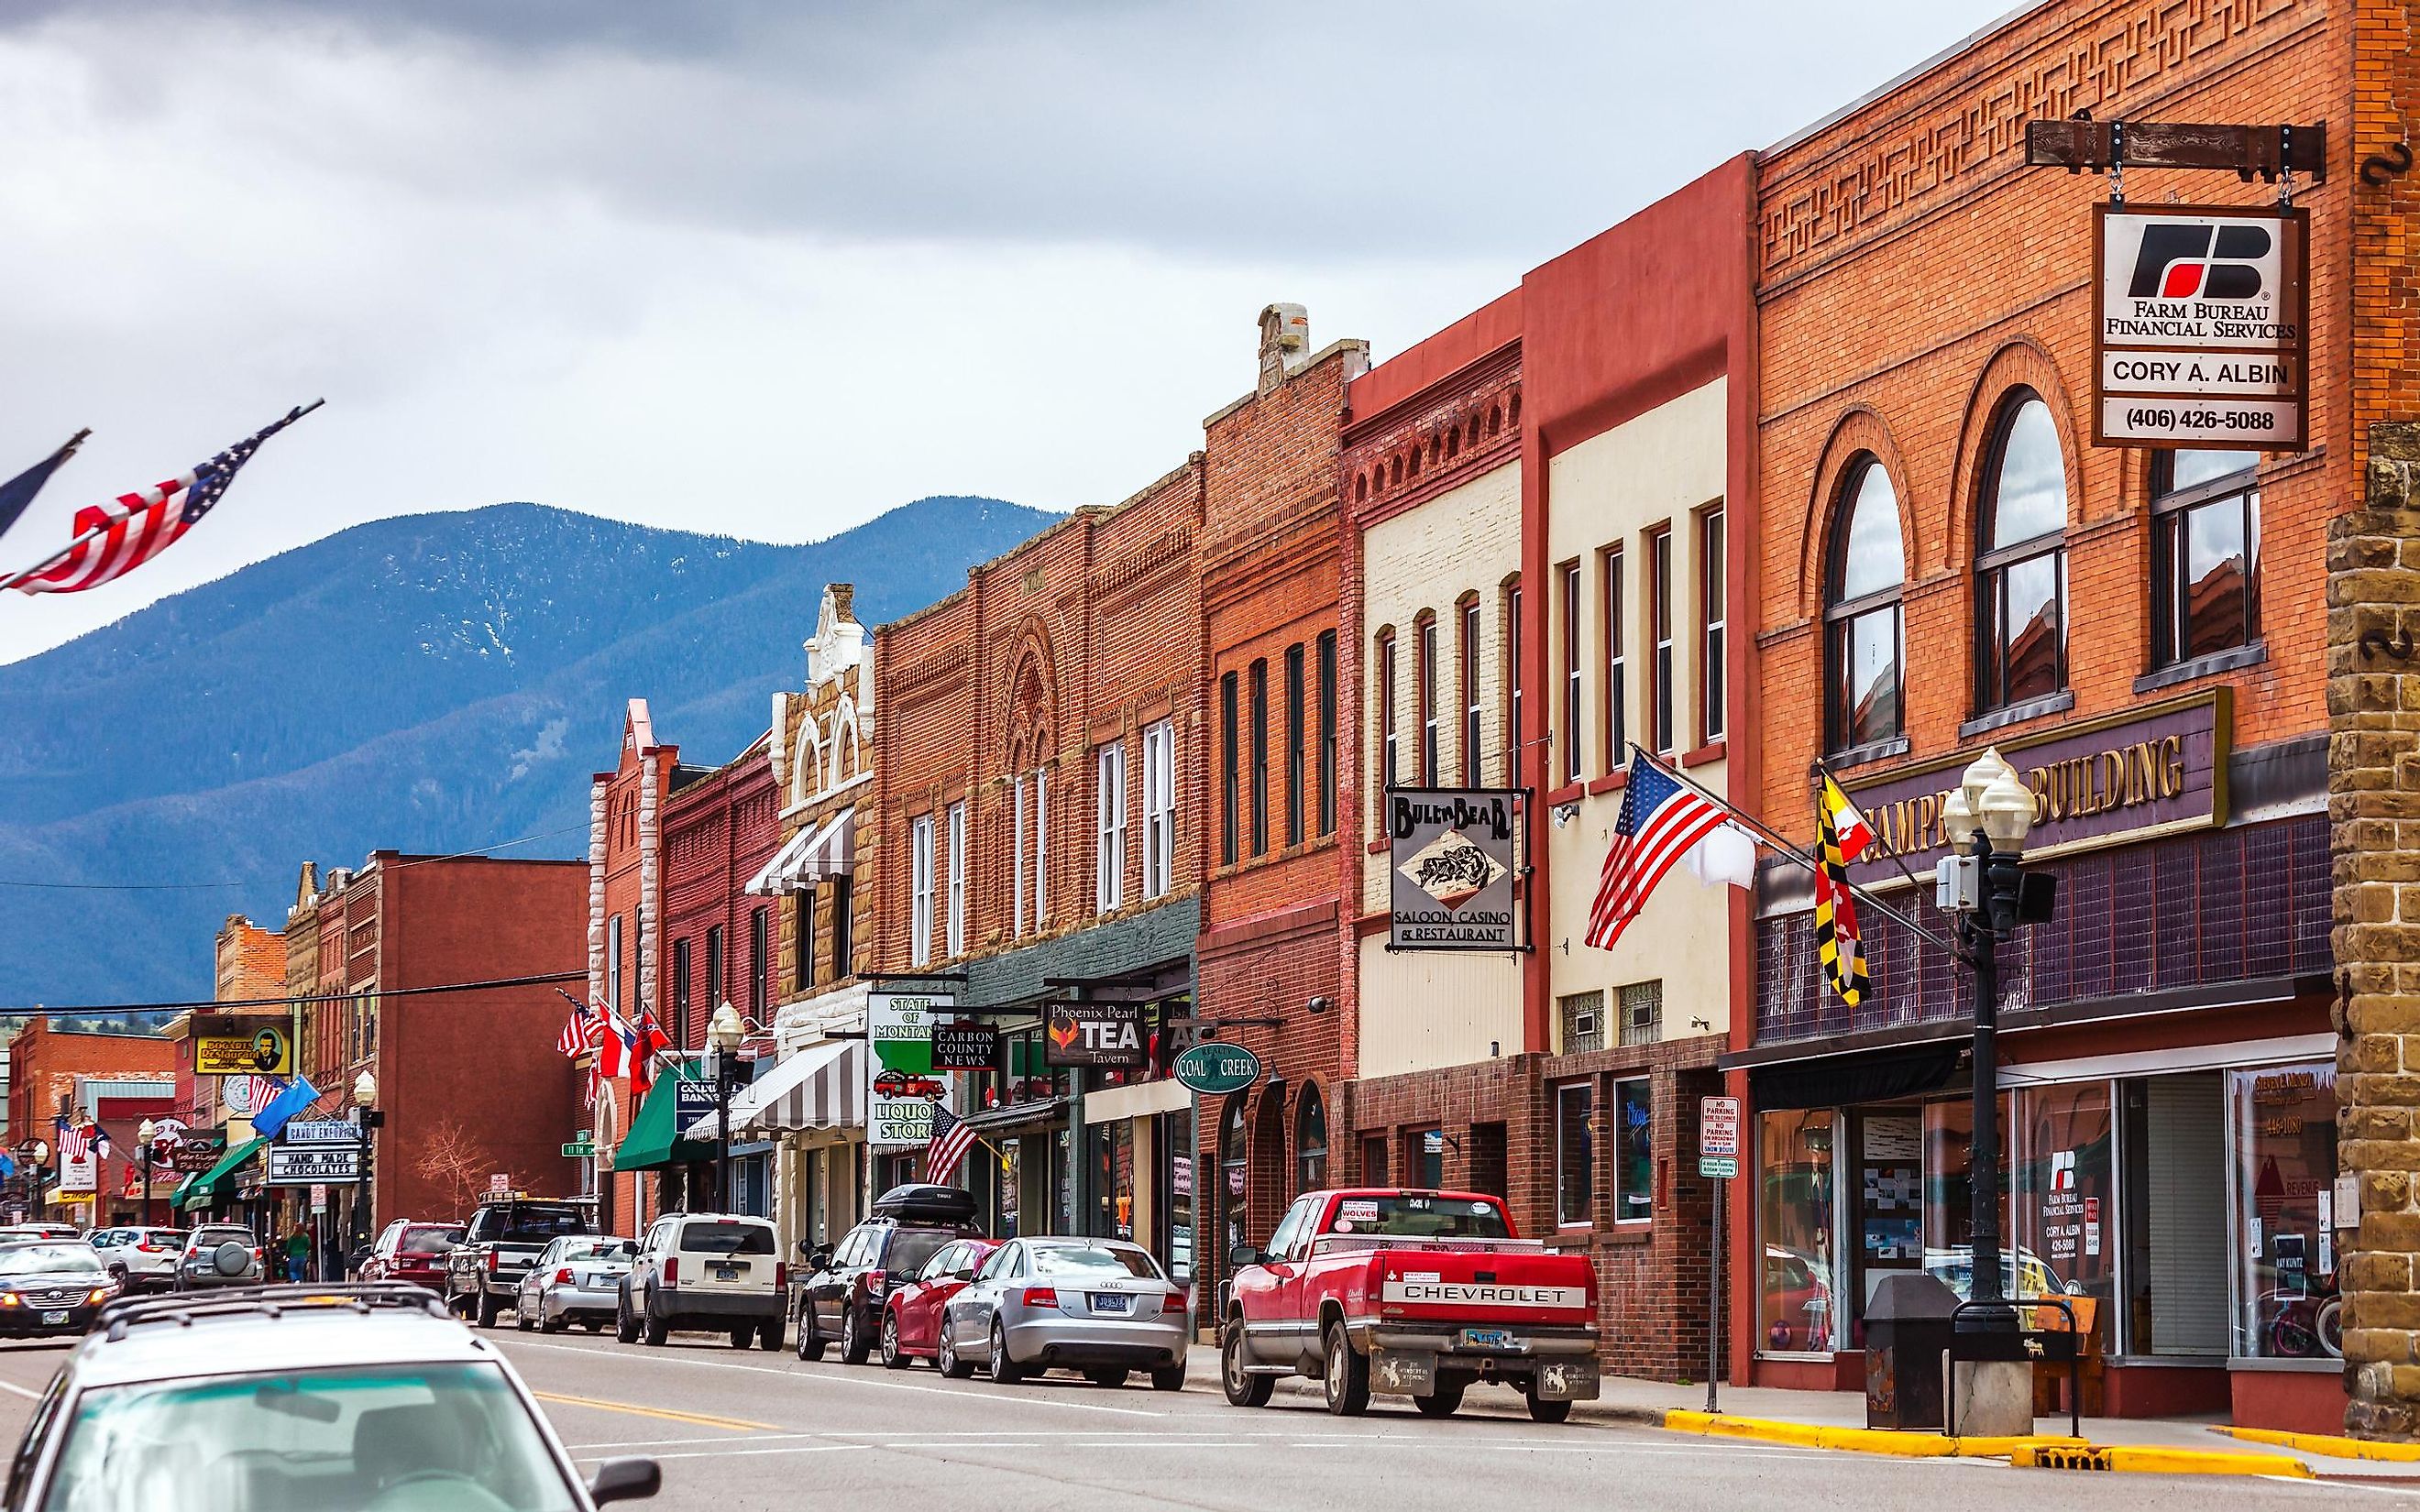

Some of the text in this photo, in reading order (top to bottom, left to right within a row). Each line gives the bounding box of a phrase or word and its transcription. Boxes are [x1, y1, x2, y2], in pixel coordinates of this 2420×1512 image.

[2134, 301, 2270, 320] FARM BUREAU
[2106, 318, 2296, 339] FINANCIAL SERVICES
[2113, 361, 2289, 384] CORY A. ALBIN
[2127, 409, 2274, 431] (406) 426-5088
[2029, 734, 2184, 826] BUILDING
[1458, 911, 1511, 924] CASINO
[1402, 928, 1505, 942] & RESTAURANT
[890, 998, 932, 1012] STATE
[1052, 1005, 1138, 1019] Phoenix Pearl
[902, 1013, 921, 1024] OF
[874, 1025, 932, 1038] MONTAN
[938, 1032, 994, 1042] CARBON
[1080, 1022, 1139, 1049] TEA
[938, 1044, 994, 1054] COUNTY
[944, 1056, 985, 1066] NEWS
[1090, 1051, 1129, 1064] Tavern
[1179, 1058, 1254, 1077] COAL CREEK
[874, 1103, 934, 1122] LIQUO
[1707, 1107, 1734, 1115] PARKING
[288, 1153, 349, 1164] HAND MADE
[283, 1164, 350, 1175] CHOCOLATES
[2286, 1181, 2320, 1195] REVENUE
[1342, 1210, 1377, 1218] WOLVES
[2286, 1257, 2304, 1268] KUNTZ
[1404, 1286, 1567, 1303] CHEVROLET
